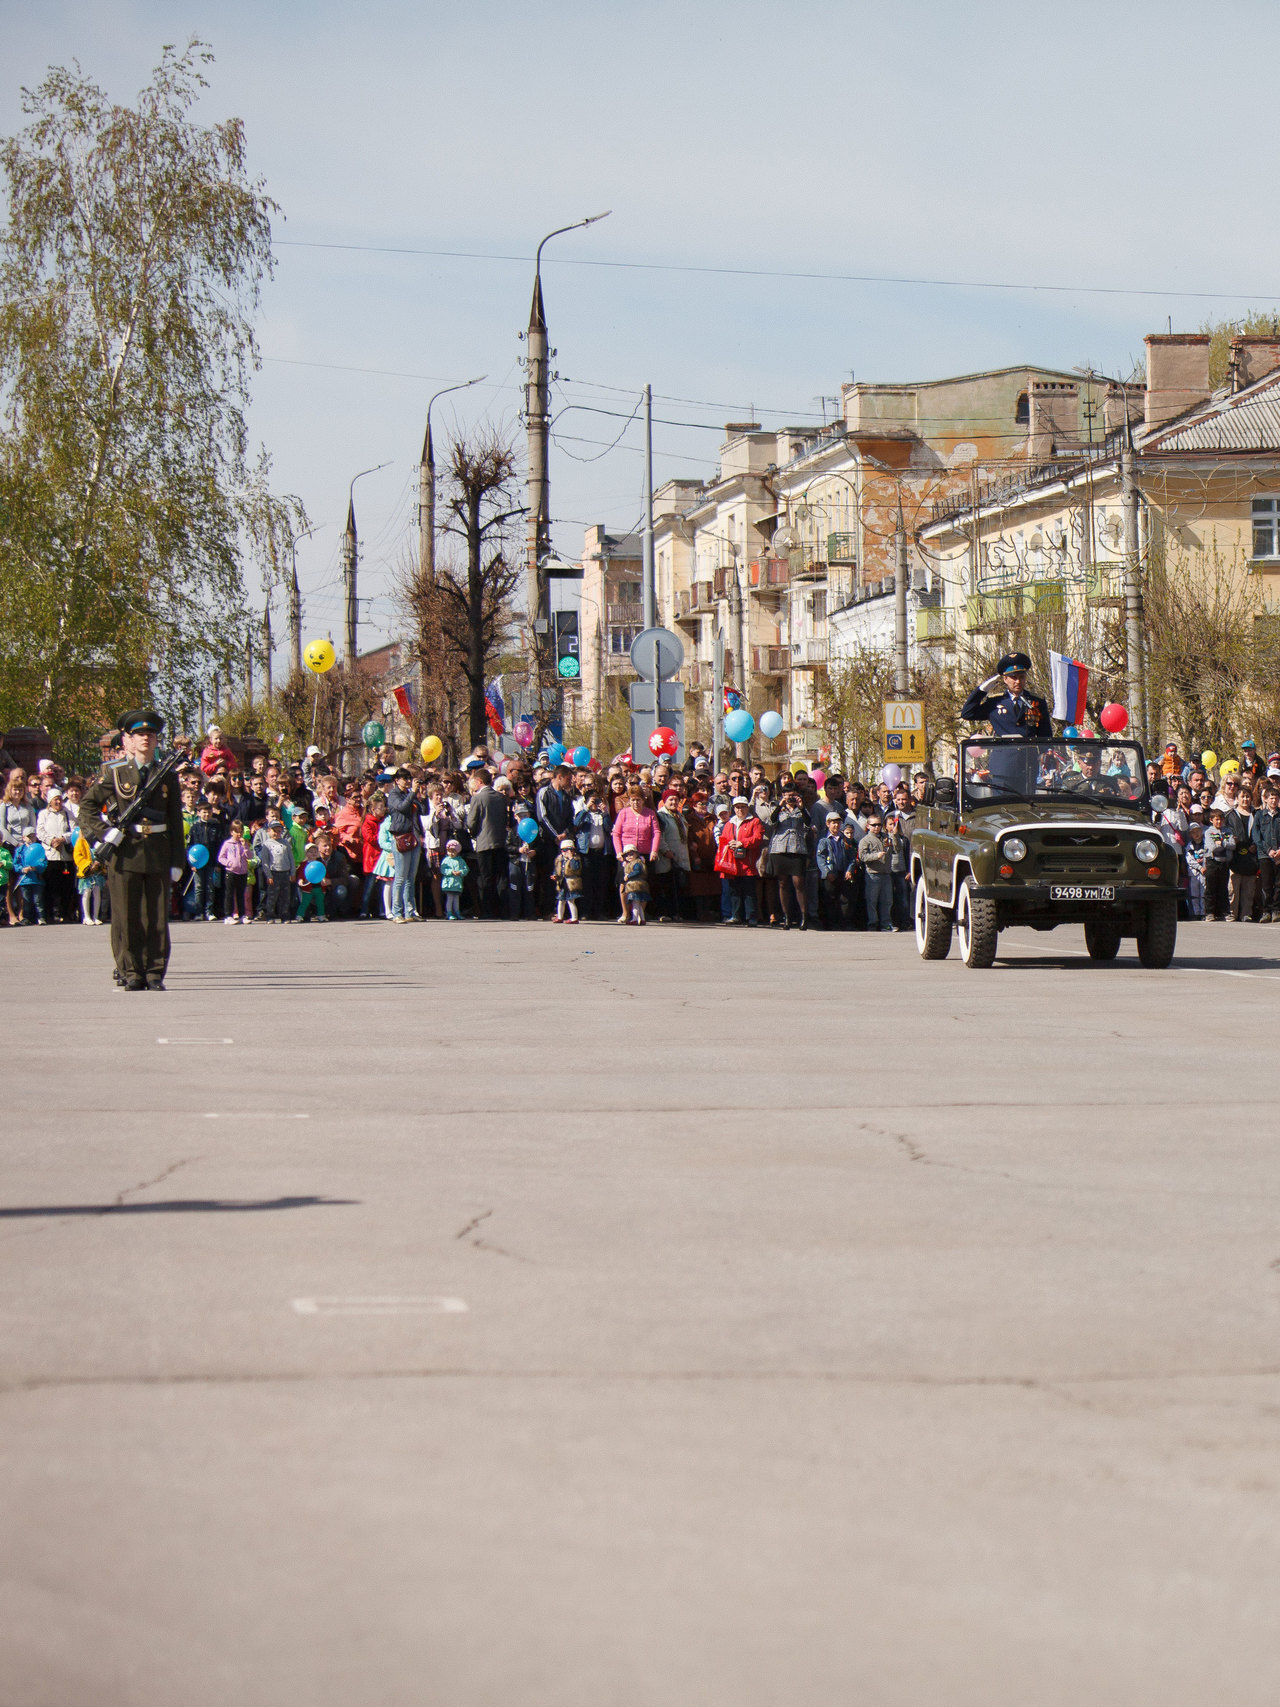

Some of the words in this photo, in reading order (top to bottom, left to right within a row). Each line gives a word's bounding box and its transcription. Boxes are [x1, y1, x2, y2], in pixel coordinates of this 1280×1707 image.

[568, 635, 578, 653] 2
[1055, 887, 1083, 899] 9498
[1100, 887, 1111, 896] 76
